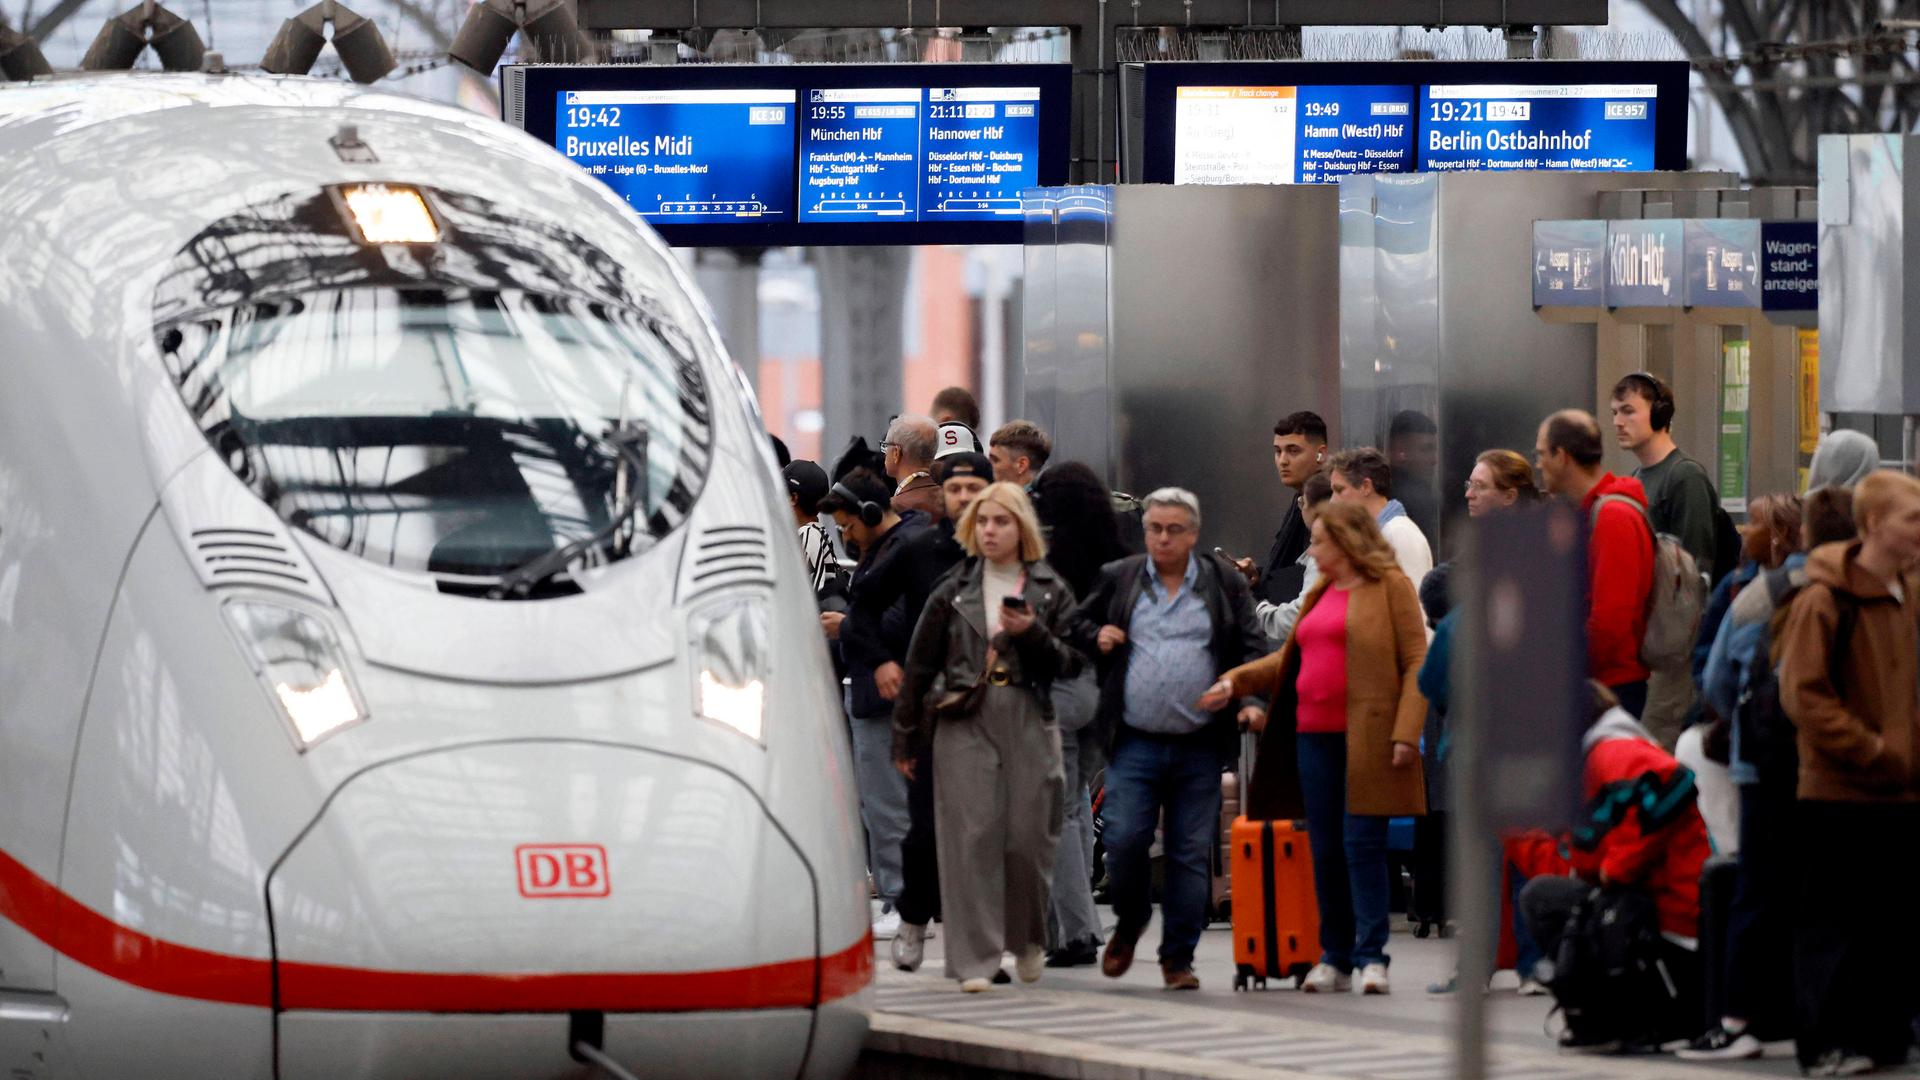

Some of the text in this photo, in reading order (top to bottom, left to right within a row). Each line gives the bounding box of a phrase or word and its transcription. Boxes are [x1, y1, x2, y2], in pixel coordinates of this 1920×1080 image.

[752, 109, 783, 121] ICE 10
[811, 106, 845, 119] 19:55
[930, 106, 964, 118] 21:11
[1305, 103, 1339, 116] 19:49
[1430, 103, 1525, 121] 19:21 19:41
[1607, 105, 1644, 116] ICE 957
[567, 107, 621, 128] 19:42
[811, 127, 882, 140] München Hbf
[929, 127, 1003, 140] Hannover Hbf
[1304, 124, 1403, 139] Hamm (Westf) Hbf
[1430, 129, 1592, 151] Berlin Ostbahnhof
[566, 136, 692, 157] Bruxelles Midi
[875, 152, 912, 161] Mannheim
[928, 151, 968, 161] Düsseldorf
[969, 151, 983, 161] Hbf
[990, 151, 1022, 162] Duisburg
[1304, 150, 1309, 158] K
[1310, 149, 1357, 159] Messe/Deutz
[1364, 149, 1403, 158] Düsseldorf
[593, 165, 607, 174] Hbf
[614, 165, 635, 175] Liège
[636, 164, 647, 175] (G)
[654, 165, 708, 174] Bruxelles-Nord
[809, 164, 823, 173] Hbf
[830, 164, 863, 175] Stuttgart
[865, 164, 878, 173] Hbf
[928, 164, 942, 172] Hbf
[949, 164, 970, 172] Essen
[972, 163, 985, 172] Hbf
[992, 163, 1021, 172] Bochum
[1303, 162, 1316, 170] Hbf
[1324, 161, 1356, 172] Duisburg
[1358, 161, 1371, 170] Hbf
[1378, 161, 1399, 170] Essen
[1428, 159, 1465, 169] Wuppertal
[1466, 159, 1480, 168] Hbf
[1487, 159, 1524, 168] Dortmund
[1524, 159, 1538, 168] Hbf
[1546, 159, 1569, 168] Hamm
[1571, 158, 1597, 169] (Westf)
[1598, 158, 1612, 167] Hbf
[809, 176, 859, 187] Augsburg Hbf
[928, 175, 941, 184] Hbf
[949, 175, 985, 184] Dortmund
[987, 175, 1000, 184] Hbf
[1303, 173, 1316, 182] Hbf
[1766, 240, 1816, 256] Wagen-
[1610, 232, 1638, 286] Köln
[1770, 258, 1813, 272] stand-
[945, 430, 958, 445] S
[528, 853, 598, 888] DB
